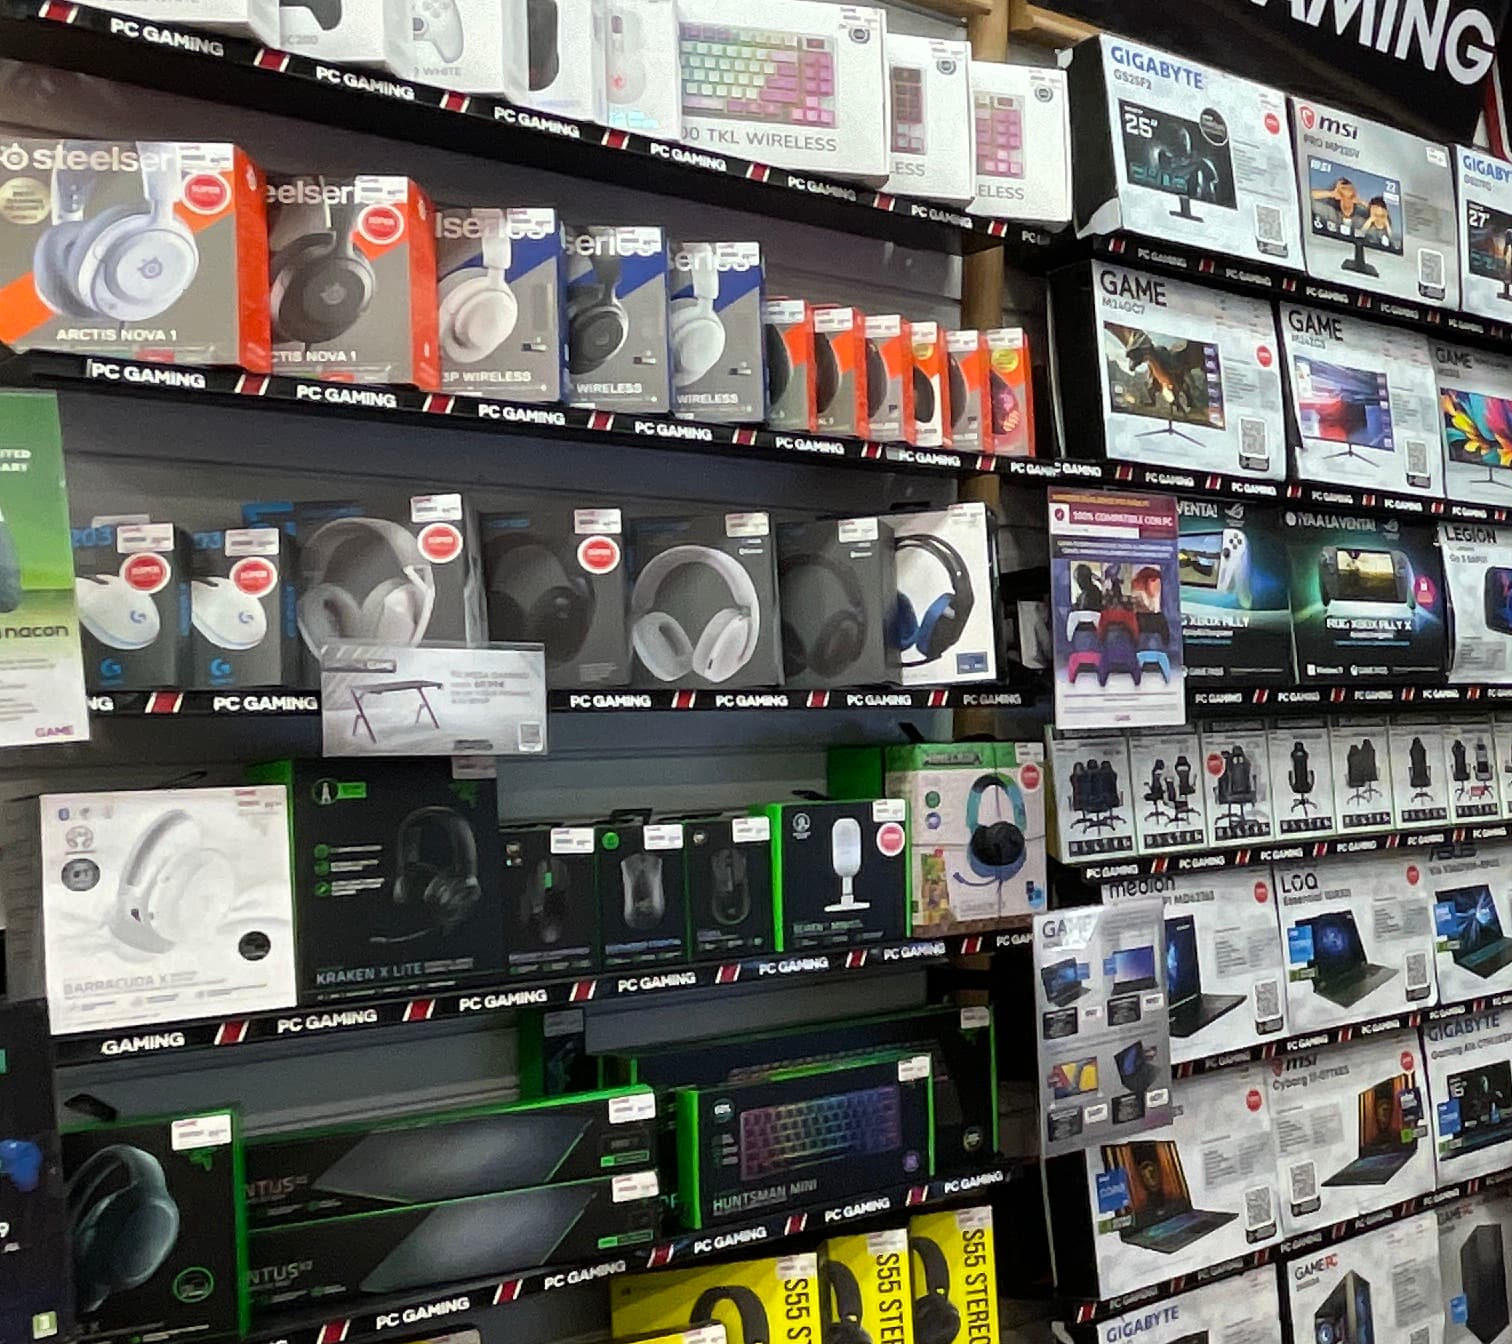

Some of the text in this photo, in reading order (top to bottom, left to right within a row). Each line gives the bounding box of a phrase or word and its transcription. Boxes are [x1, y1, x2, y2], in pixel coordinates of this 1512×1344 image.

[111, 18, 224, 57] PC GAMING
[1111, 46, 1205, 90] GIGABYTE
[494, 107, 580, 138] PC GAMING
[1319, 115, 1358, 140] msi
[707, 127, 837, 152] TKL WIRELESS
[33, 143, 177, 172] steelser
[976, 184, 1025, 200] ELESS
[1100, 270, 1167, 307] GAME
[56, 329, 177, 341] ARCTIS NOVA 1
[1288, 309, 1343, 341] GAME
[271, 351, 356, 362] CTIS NOVA 1
[1435, 347, 1473, 369] GAME
[92, 363, 206, 389] PC GAMING
[463, 371, 532, 383] WIRELESS
[296, 385, 397, 408] PC GAMING
[577, 383, 643, 394] WIRELESS
[677, 394, 739, 404] WIRELESS
[478, 404, 566, 426] PC GAMING
[5, 624, 69, 638] nacon
[213, 696, 318, 711] PC GAMING
[570, 694, 652, 708] PC GAMING
[1281, 873, 1318, 894] LOQ
[316, 968, 376, 985] KRAKEN
[378, 967, 389, 978] X
[393, 962, 422, 976] LITE
[63, 976, 155, 996] BARRACUDA
[459, 990, 548, 1012] PC GAMING
[1428, 1014, 1500, 1041] GIGABYTE
[101, 1032, 185, 1055] GAMING
[713, 1179, 818, 1212] HUNTSMAN MINI
[962, 1228, 986, 1268] S55
[876, 1253, 900, 1295] S55
[784, 1278, 810, 1324] S55
[377, 1297, 470, 1330] PC GAMING
[1106, 1304, 1180, 1344] GIGABYTE
